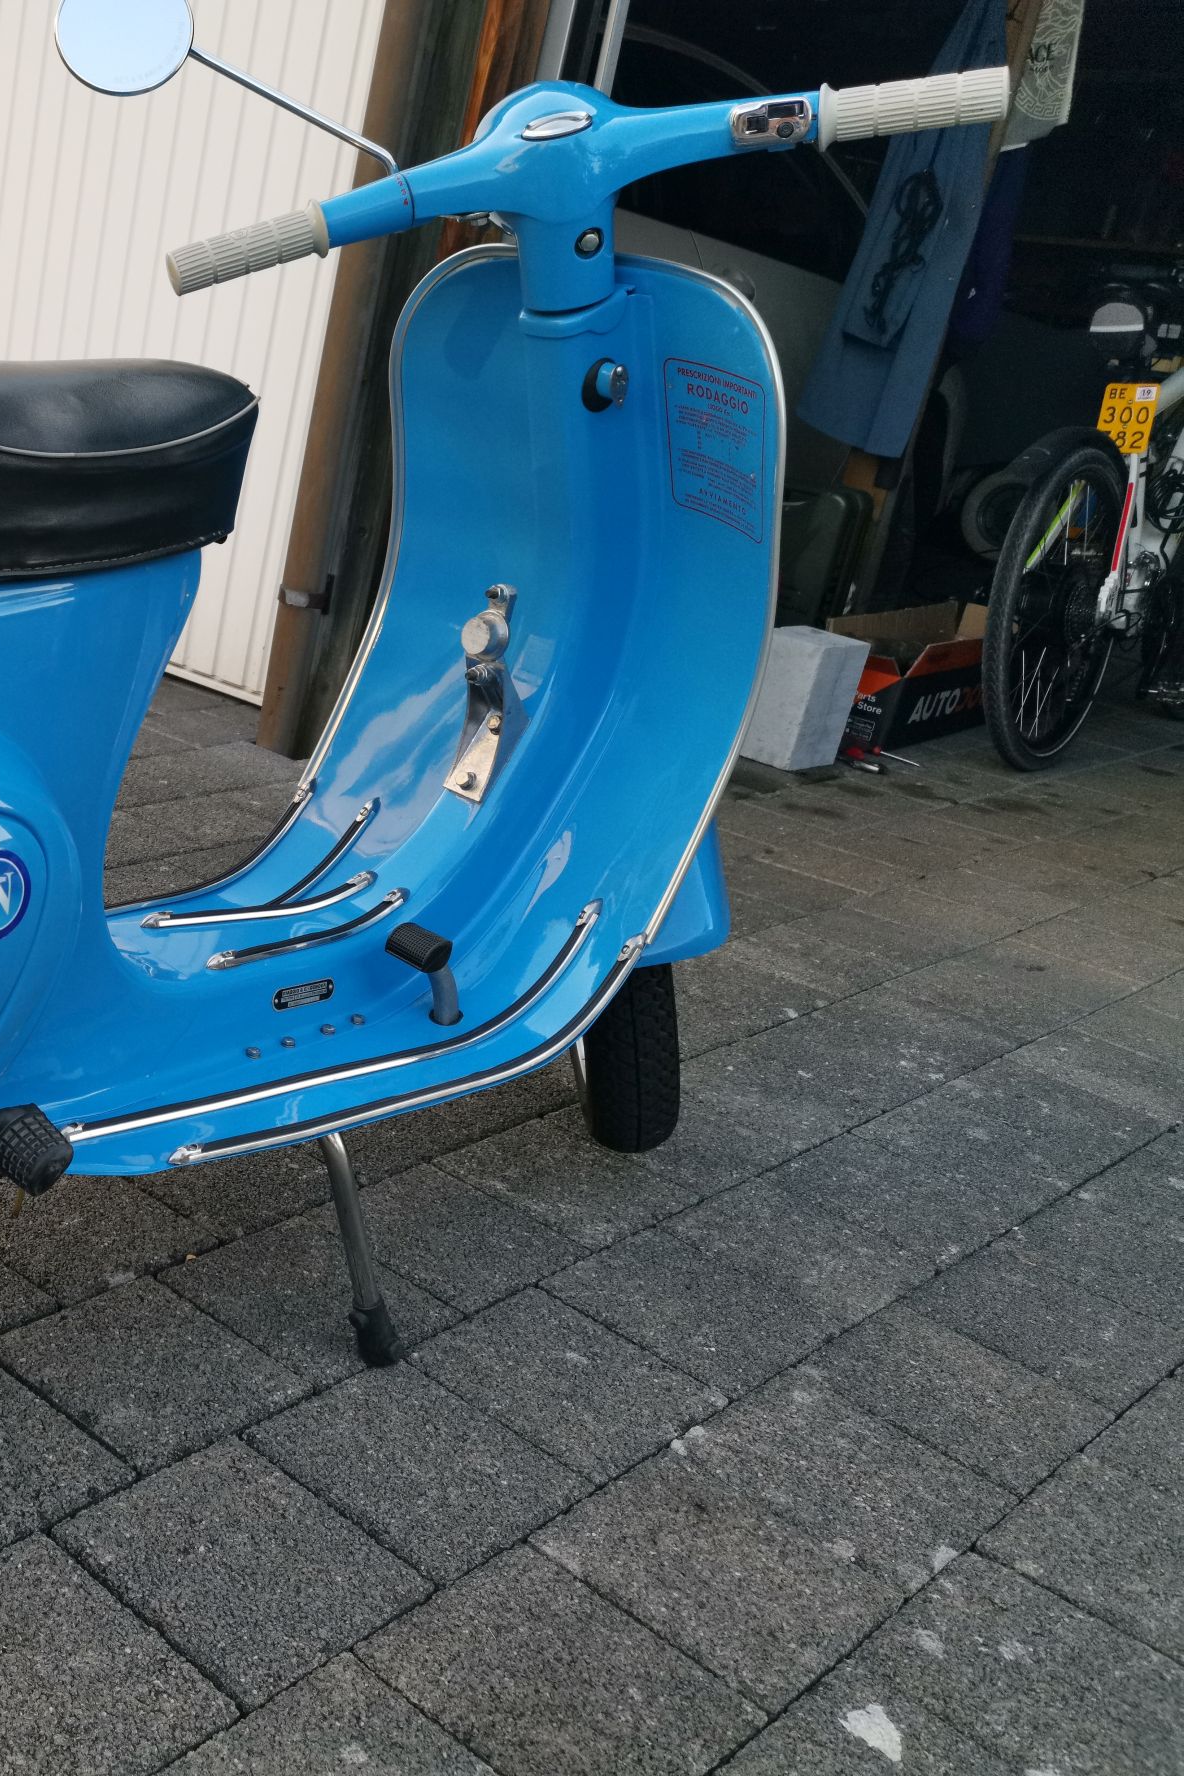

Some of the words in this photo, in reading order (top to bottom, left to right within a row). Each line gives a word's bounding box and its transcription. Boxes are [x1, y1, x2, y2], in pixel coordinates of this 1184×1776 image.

[687, 383, 749, 415] RODAGGIO
[1109, 388, 1128, 400] BE
[1103, 406, 1150, 424] 300
[1109, 431, 1144, 449] 82
[857, 701, 883, 715] Store
